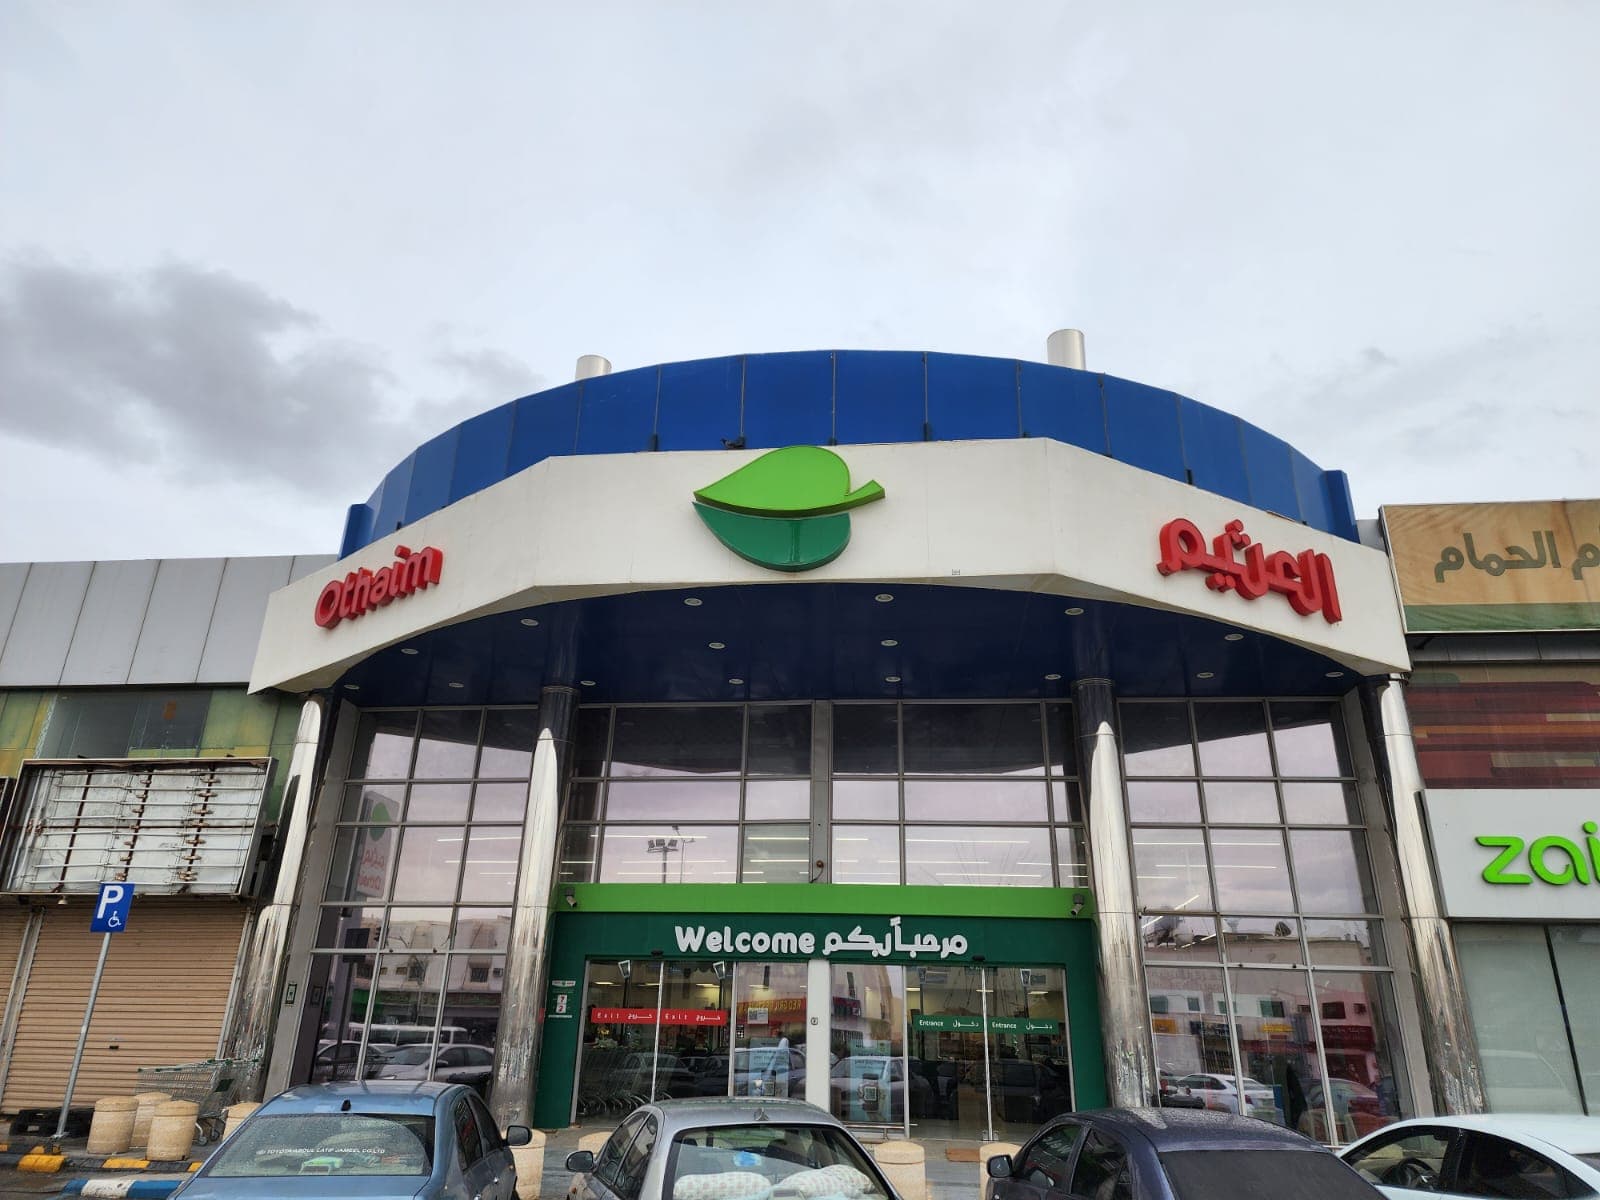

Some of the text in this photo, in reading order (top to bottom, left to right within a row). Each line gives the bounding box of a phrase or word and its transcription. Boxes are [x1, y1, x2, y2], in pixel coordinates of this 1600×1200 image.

[1156, 518, 1342, 624] العثيم
[1434, 530, 1561, 583] الحمام
[314, 544, 443, 630] Othaim
[97, 885, 124, 919] P
[675, 925, 815, 955] Welcome
[919, 1019, 944, 1027] Entrance
[991, 1021, 1017, 1029] Entrance
